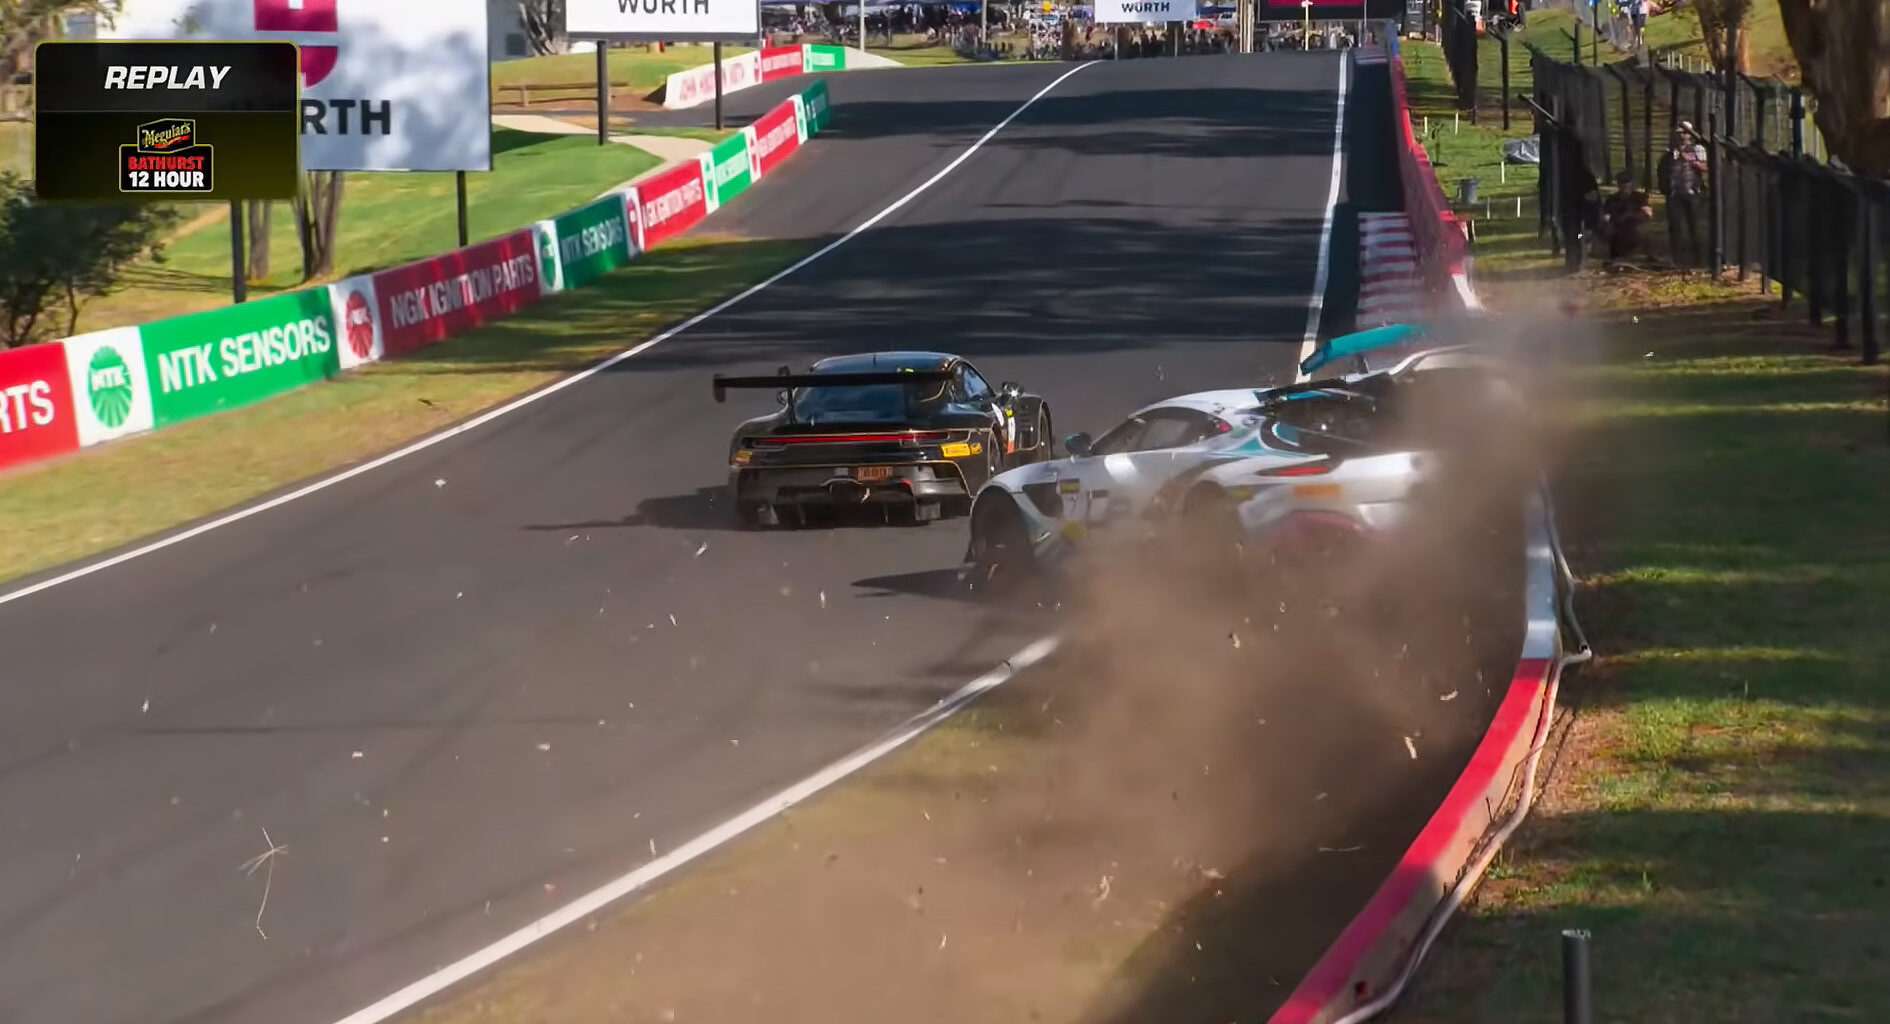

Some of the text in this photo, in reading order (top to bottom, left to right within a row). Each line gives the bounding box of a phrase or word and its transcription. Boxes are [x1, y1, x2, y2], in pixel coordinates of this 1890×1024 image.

[301, 99, 391, 135] RTH
[390, 254, 534, 328] NGK IGNITION PARTS
[157, 315, 331, 394] NTK SENSORS
[0, 380, 55, 434] RTS
